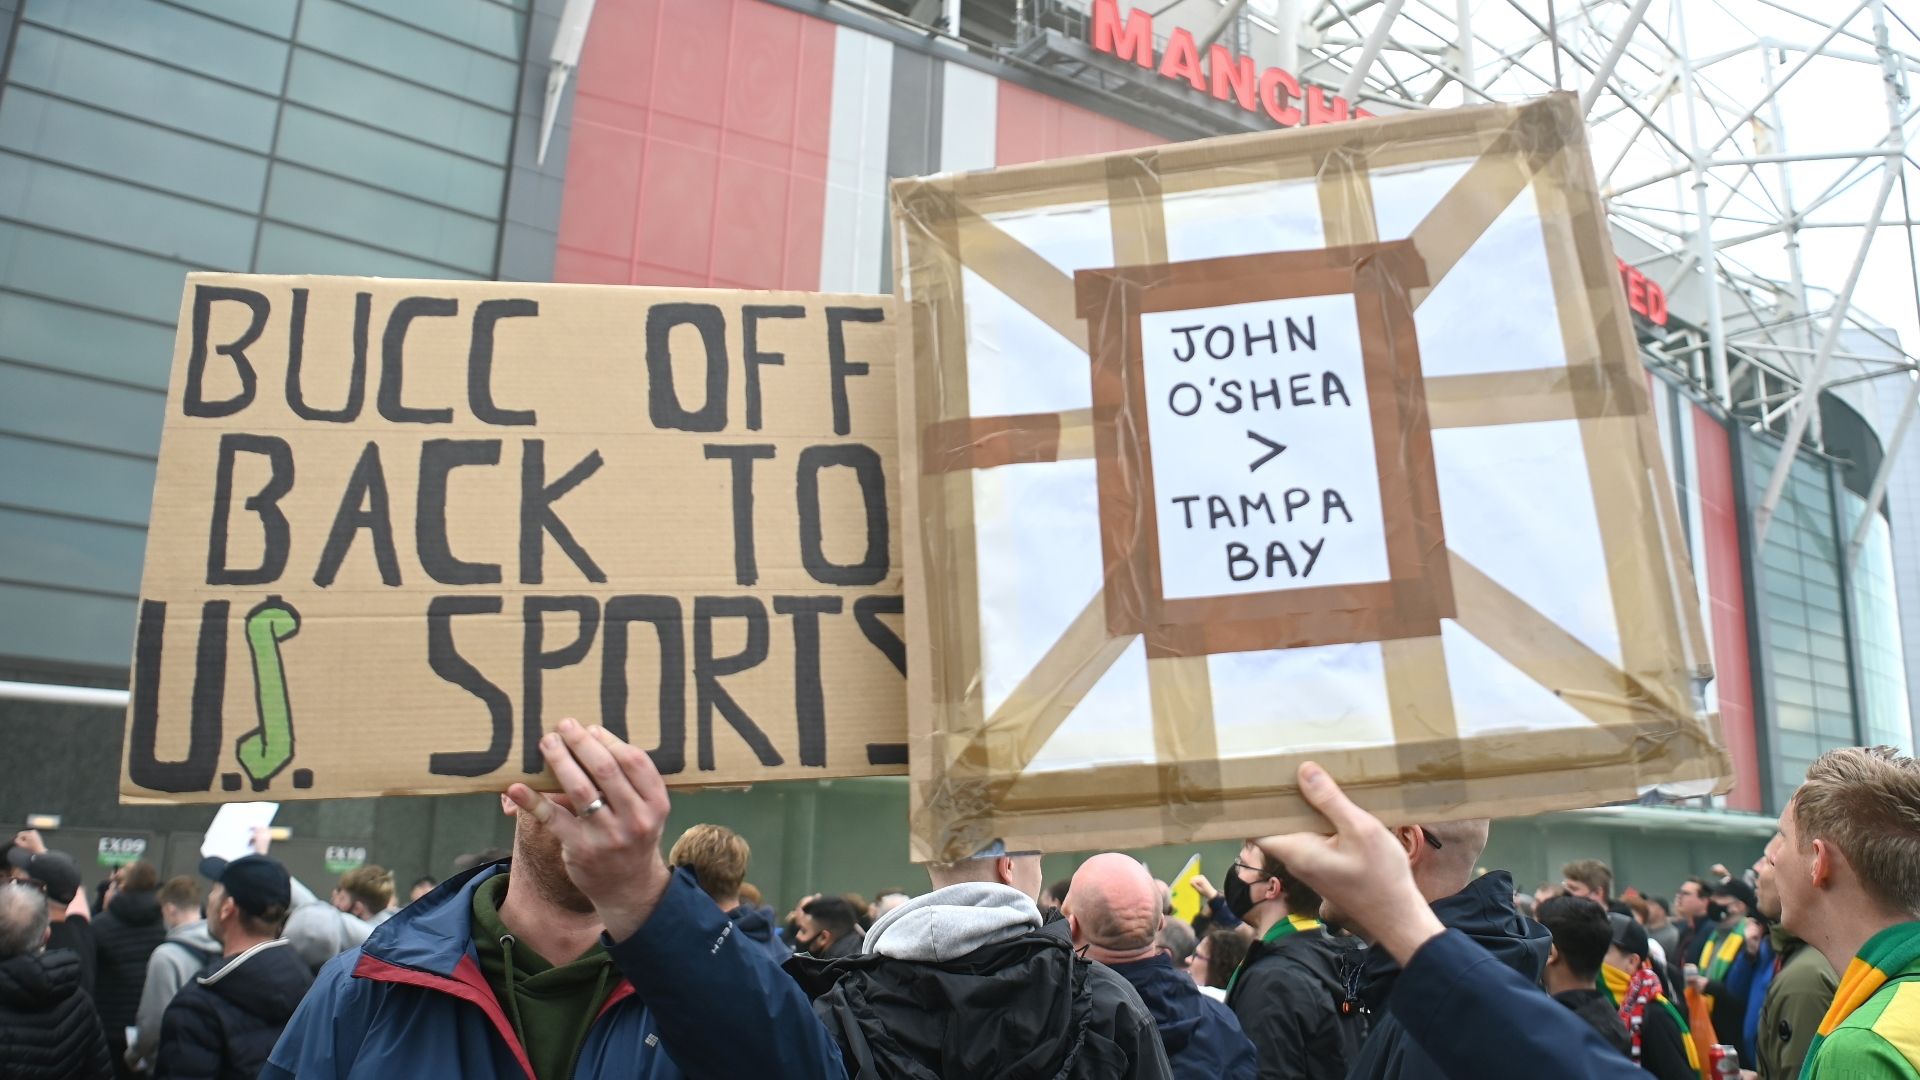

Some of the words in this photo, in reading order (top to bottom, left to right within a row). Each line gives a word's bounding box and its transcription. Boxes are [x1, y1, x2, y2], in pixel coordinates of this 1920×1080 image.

[1092, 0, 1378, 127] MANCH
[183, 284, 539, 425] BUCC
[645, 302, 885, 436] OFF
[1171, 315, 1317, 362] JOHN
[1168, 370, 1351, 416] O'SHEA
[206, 433, 607, 588] BACK
[703, 443, 890, 586] TO
[1171, 488, 1353, 529] TAMPA
[1226, 537, 1325, 581] BAY
[427, 594, 909, 777] SPORTS
